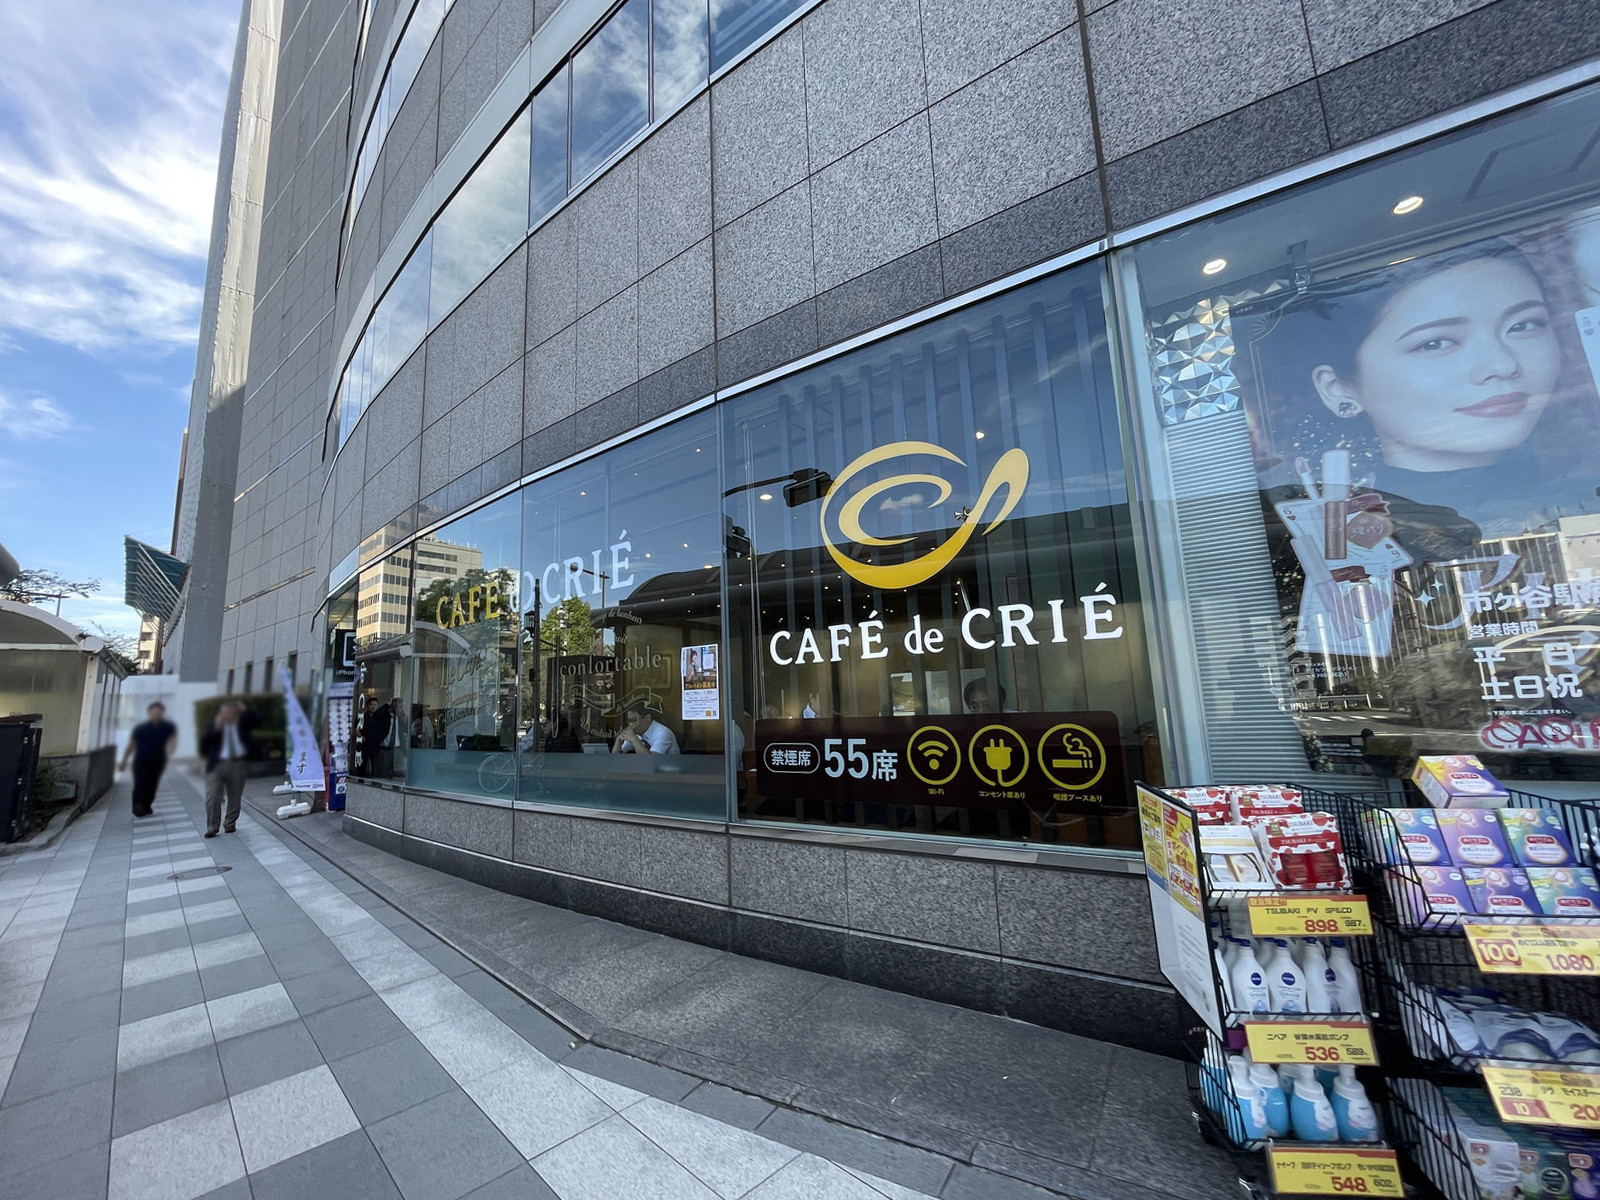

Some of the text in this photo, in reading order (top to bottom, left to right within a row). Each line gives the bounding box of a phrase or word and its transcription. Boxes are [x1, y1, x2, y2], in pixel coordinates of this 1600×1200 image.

[542, 528, 635, 604] CRIÉ
[769, 582, 1123, 667] CAFÉ de CRIÉ
[1469, 620, 1539, 639] 営業時間
[1480, 673, 1583, 702] 土日祝
[771, 749, 811, 767] 禁煙席
[1304, 919, 1338, 932] 898
[1479, 943, 1519, 962] 100
[1304, 1046, 1340, 1061] 536
[1513, 1102, 1531, 1115] 10
[1331, 1176, 1367, 1192] 548
